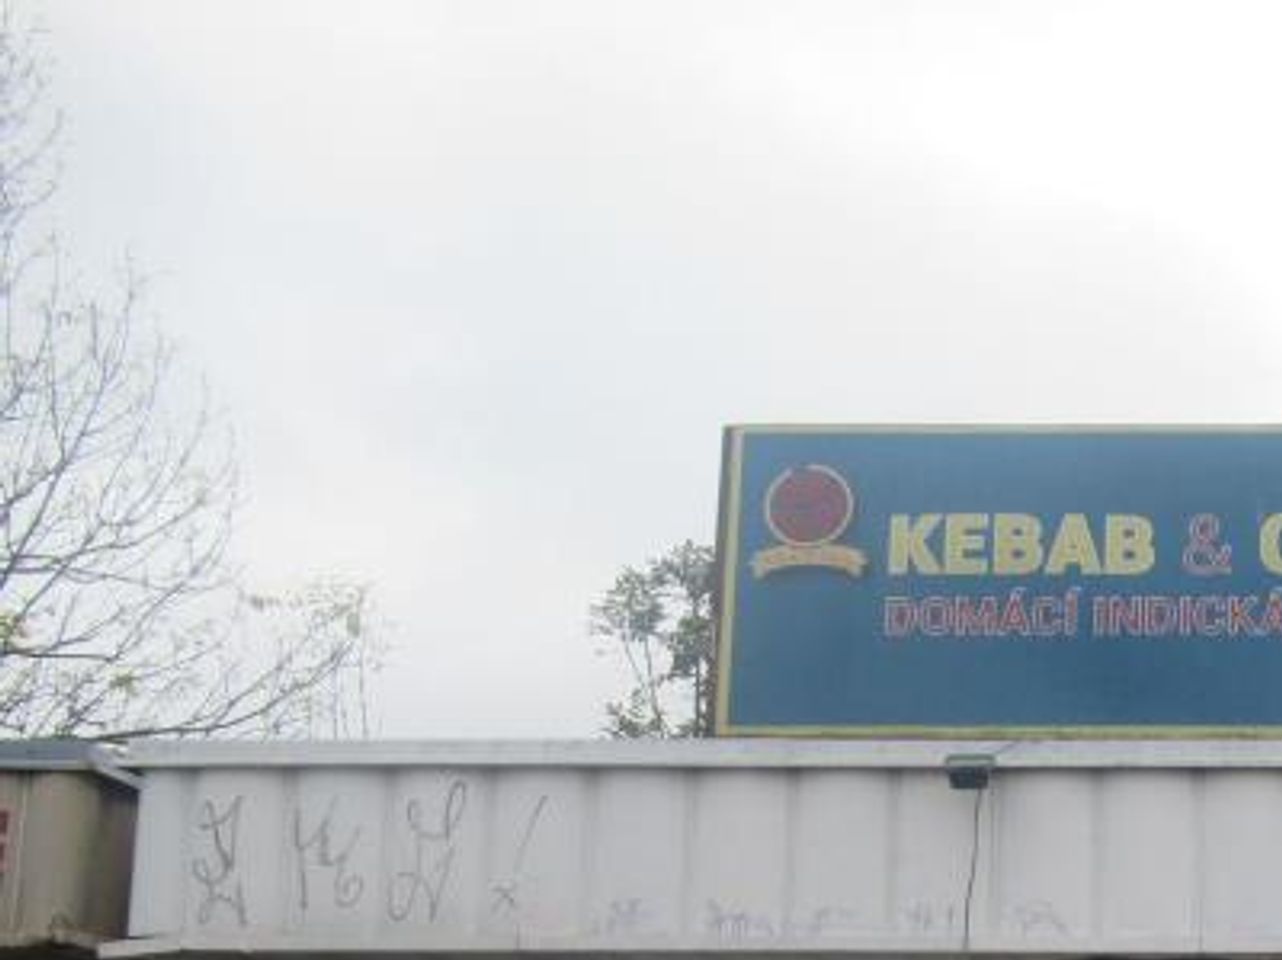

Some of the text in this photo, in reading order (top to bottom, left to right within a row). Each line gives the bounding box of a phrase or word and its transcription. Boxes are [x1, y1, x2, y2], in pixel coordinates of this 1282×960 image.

[888, 513, 1156, 576] KEBAB
[1182, 513, 1232, 576] &
[884, 587, 1082, 636] DOMÁCÍ
